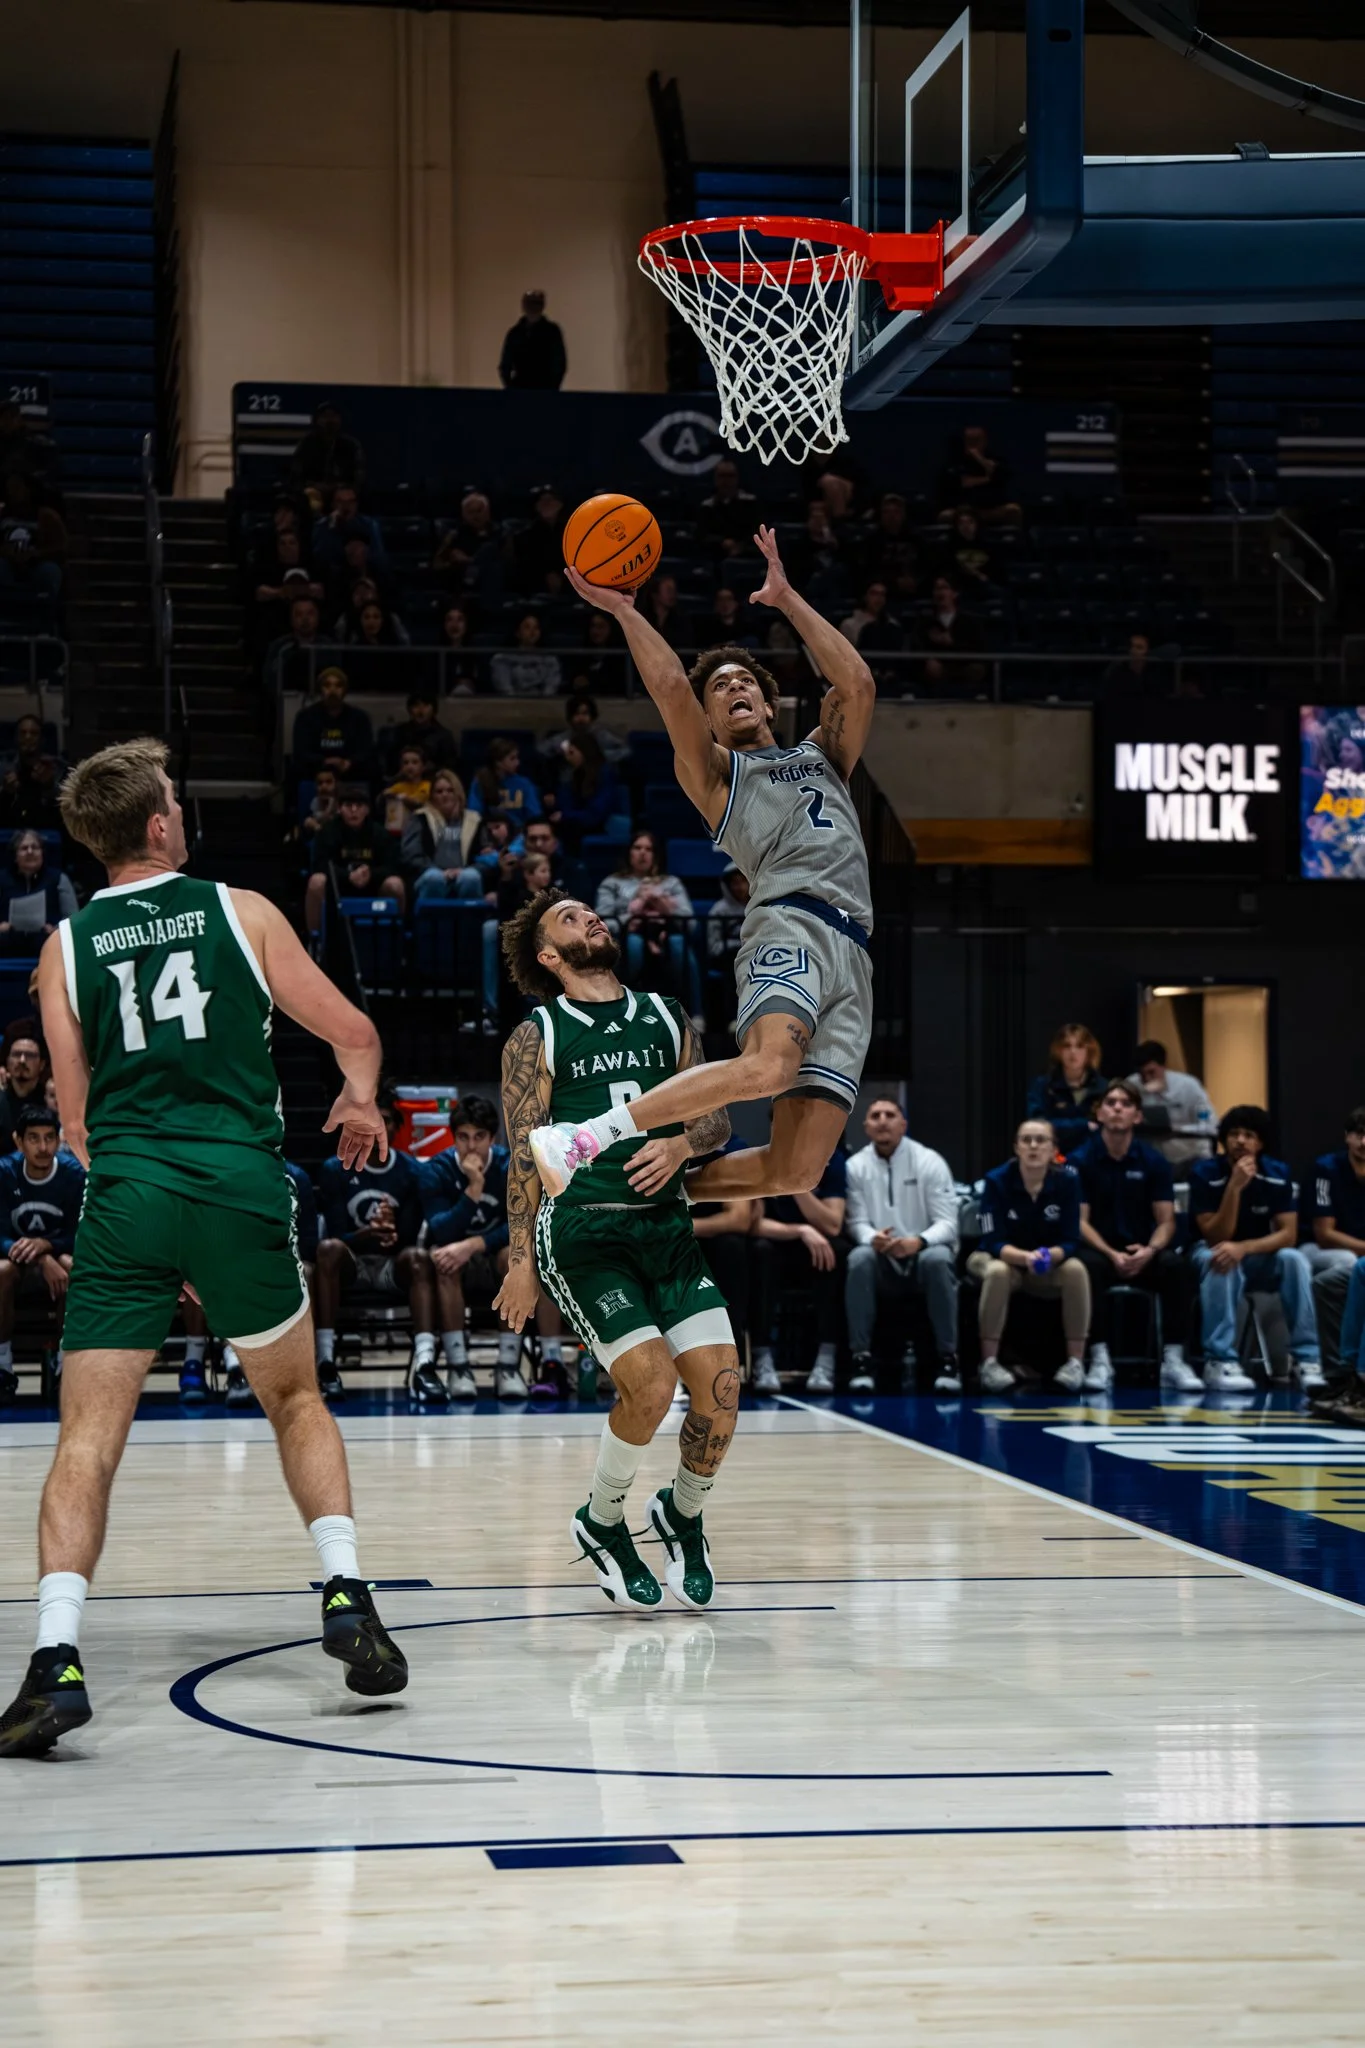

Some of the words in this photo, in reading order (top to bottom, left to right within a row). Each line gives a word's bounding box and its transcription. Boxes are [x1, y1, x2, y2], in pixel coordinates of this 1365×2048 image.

[8, 385, 38, 402] 211
[247, 393, 283, 412] 212
[768, 761, 824, 786] AGGIES
[1114, 742, 1281, 793] MUSCLE
[798, 785, 835, 830] 2
[91, 910, 206, 957] ROUHLIADEFF
[106, 949, 213, 1053] 14
